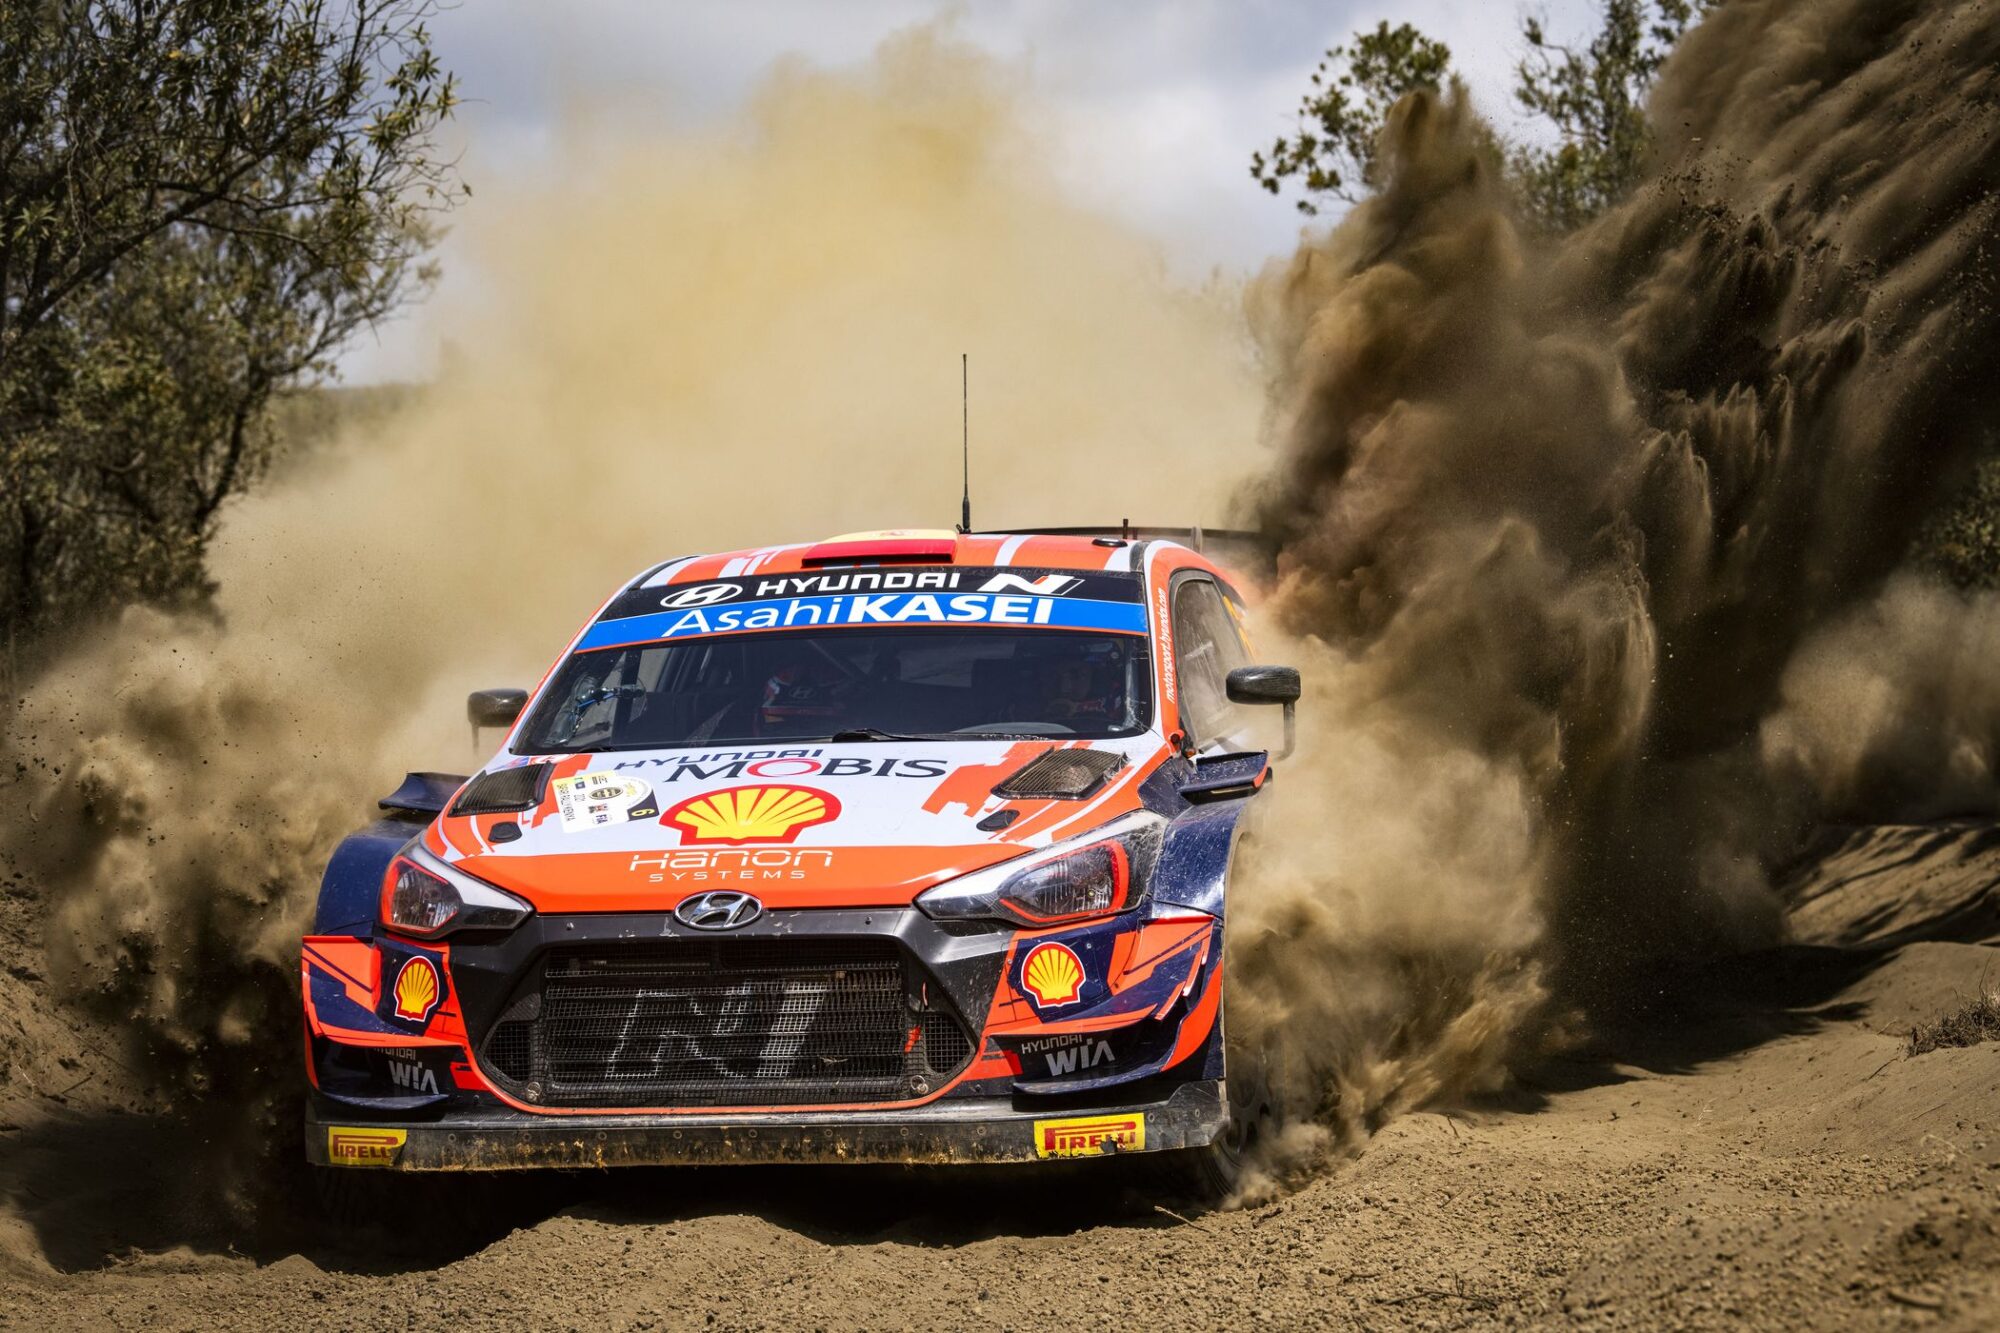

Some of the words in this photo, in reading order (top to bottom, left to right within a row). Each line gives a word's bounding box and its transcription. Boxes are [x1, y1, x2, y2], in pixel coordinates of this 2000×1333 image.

[755, 572, 960, 597] HYUNDAI
[613, 749, 824, 771] HYUNDAI
[662, 758, 947, 783] MOBIS
[631, 808, 655, 817] 6
[629, 850, 833, 872] Hanon
[649, 870, 806, 883] SYSTEMS
[1021, 1034, 1083, 1054] HYUNDAI
[333, 1134, 398, 1159] PIRELL
